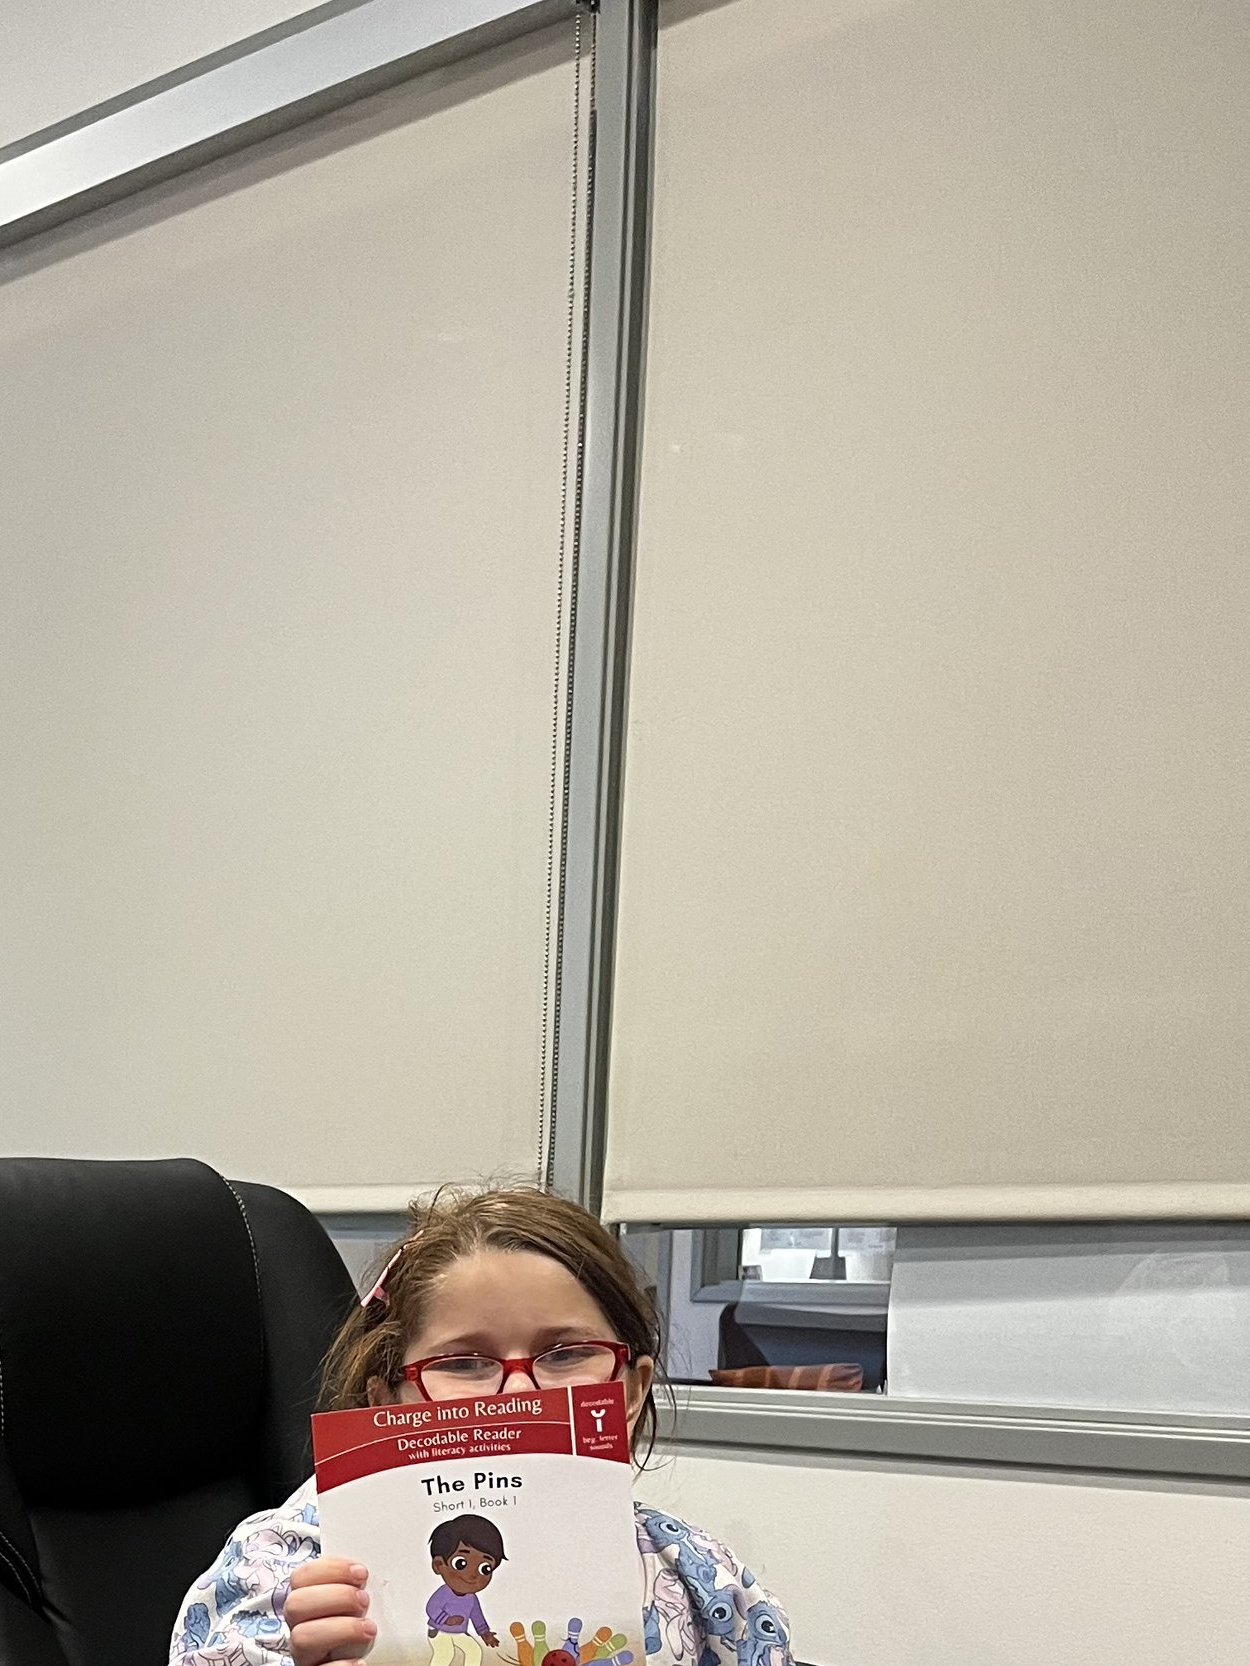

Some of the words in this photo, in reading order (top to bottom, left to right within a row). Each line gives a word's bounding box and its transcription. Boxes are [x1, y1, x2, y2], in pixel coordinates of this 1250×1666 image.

[373, 1410, 432, 1428] Charge
[437, 1407, 469, 1420] into
[475, 1398, 542, 1417] Reading
[398, 1432, 468, 1451] Decodable
[473, 1428, 521, 1440] Reader
[409, 1450, 429, 1460] with
[432, 1447, 465, 1457] literacy
[469, 1443, 511, 1453] activities
[421, 1475, 464, 1495] The
[474, 1472, 522, 1489] Pins
[433, 1502, 464, 1512] Short
[480, 1497, 508, 1508] Book
[513, 1496, 517, 1505] 1
